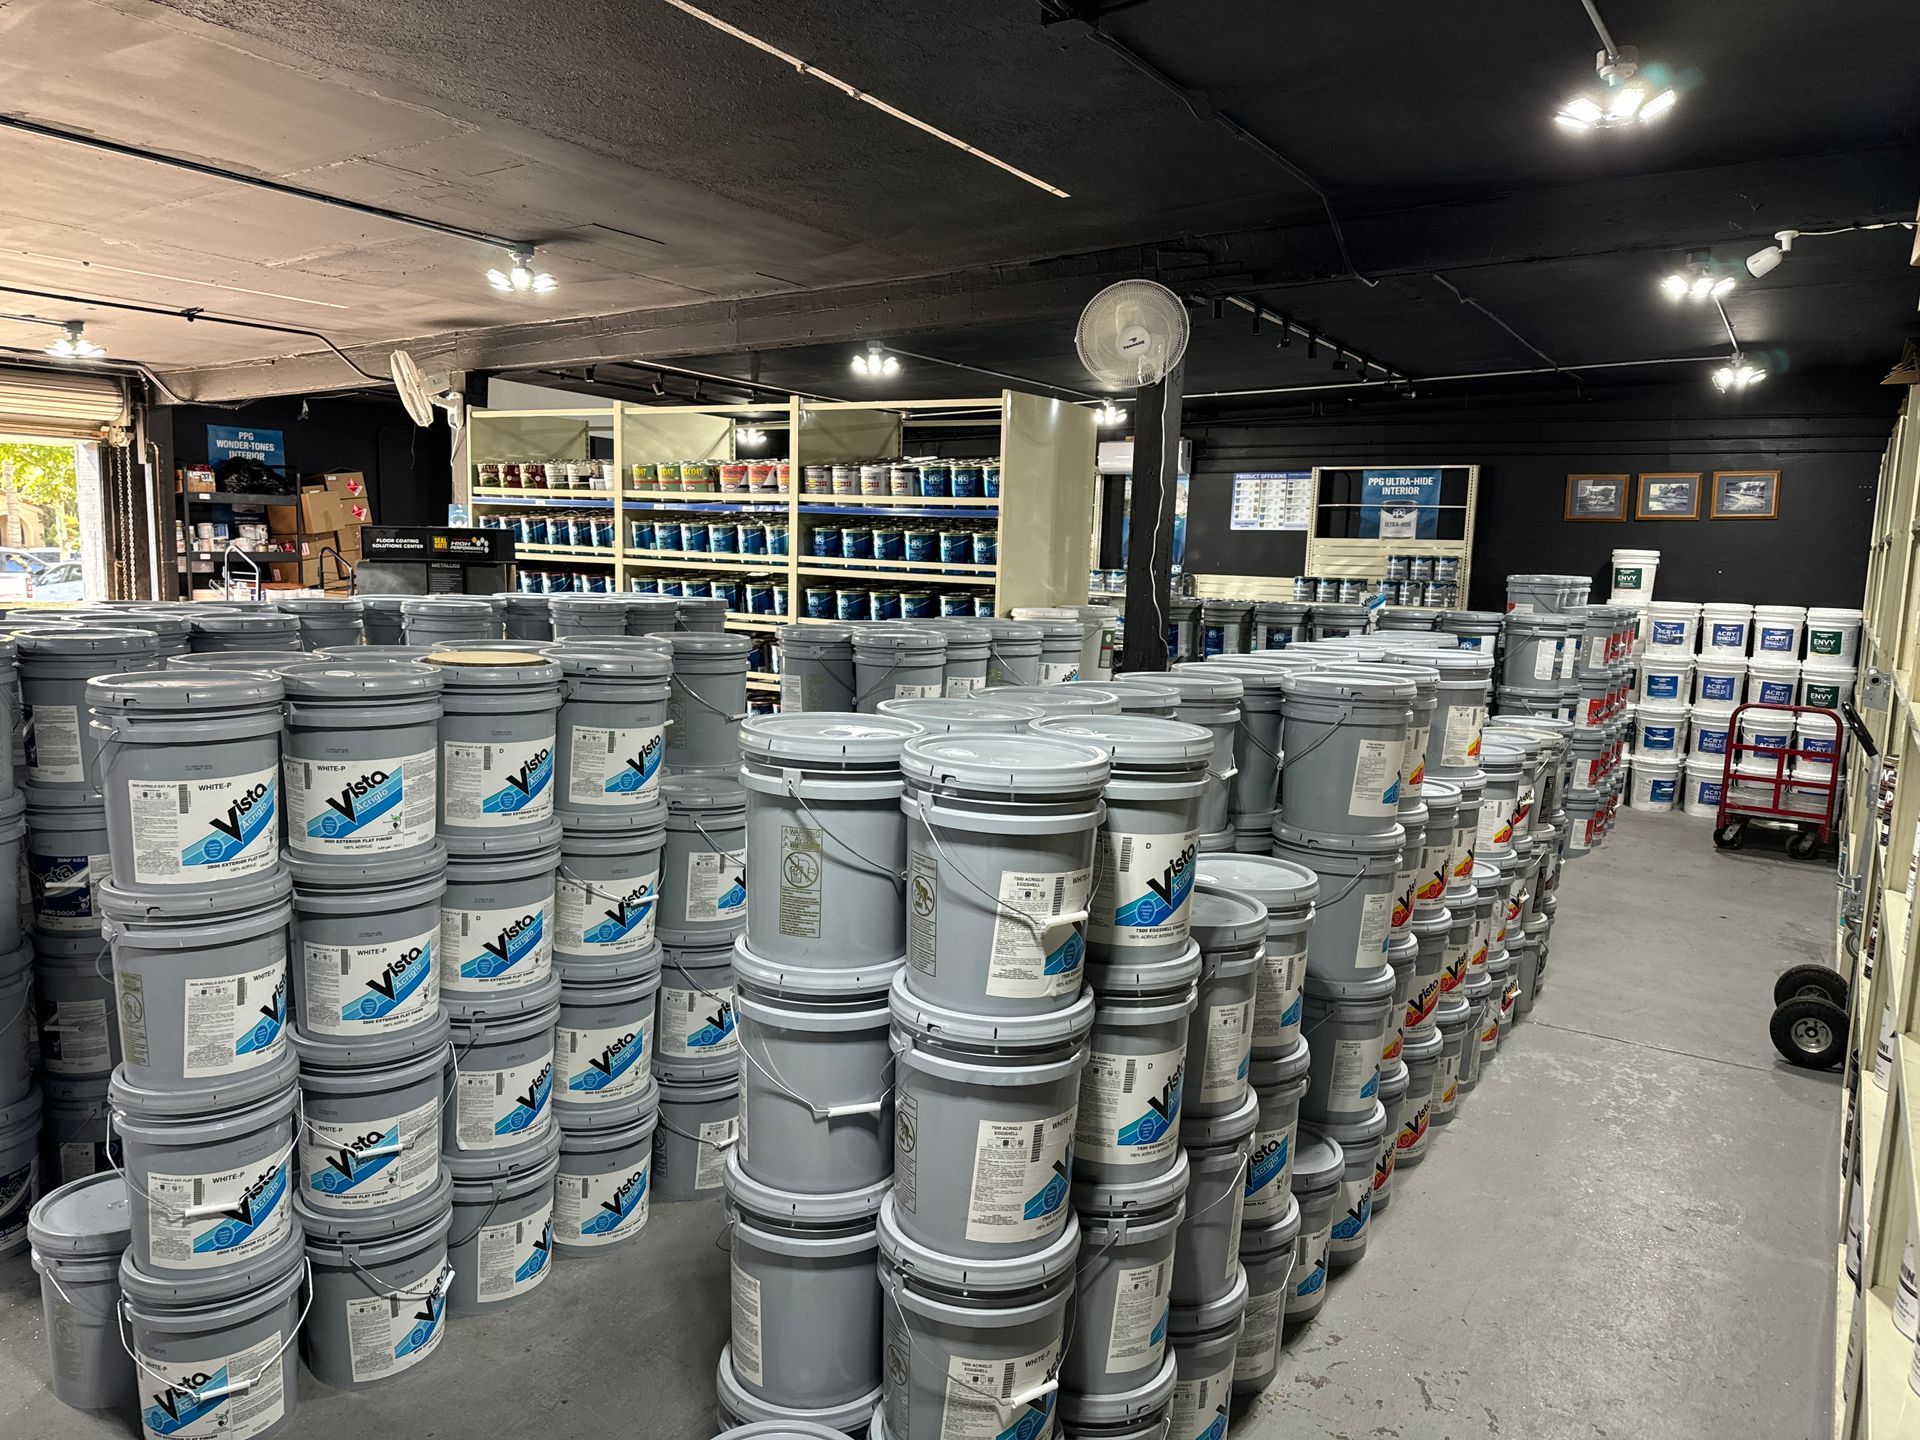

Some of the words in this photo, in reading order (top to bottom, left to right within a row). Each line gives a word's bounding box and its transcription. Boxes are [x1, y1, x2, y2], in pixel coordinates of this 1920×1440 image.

[216, 440, 275, 451] WONDER-TONES
[238, 432, 254, 440] PPG
[1368, 478, 1384, 486] PPG
[1386, 477, 1434, 486] ULTRA-HIDE
[1382, 486, 1420, 495] INTERIOR
[626, 734, 660, 778] Vista
[505, 748, 549, 796] Vista
[198, 782, 232, 791] WHITE-P
[325, 770, 390, 824] Vista
[356, 788, 388, 813] Acriglo
[208, 783, 268, 844] Vista
[242, 802, 268, 830] Acriglo
[222, 858, 248, 868] EXTERIOR
[1146, 843, 1196, 906] Vista
[356, 948, 387, 956] WHITE-P
[482, 914, 536, 963] Vista
[509, 930, 534, 952] Acriglo
[365, 947, 422, 1001] Vista
[395, 964, 422, 990] Acriglo
[1408, 979, 1438, 1015] Vista
[376, 1014, 400, 1024] EXTERIOR
[588, 1033, 636, 1077] Vista
[516, 1062, 552, 1110] Vista
[1405, 1100, 1431, 1136] Vista
[325, 1131, 386, 1181] Vista
[1254, 1156, 1279, 1178] Acriglo
[212, 1172, 244, 1184] WHITE-P
[220, 1165, 280, 1226] Vista
[252, 1182, 279, 1213] Acriglo
[600, 1172, 642, 1216] Vista
[231, 1241, 257, 1252] EXTERIOR
[1025, 1350, 1051, 1368] WHITE-P
